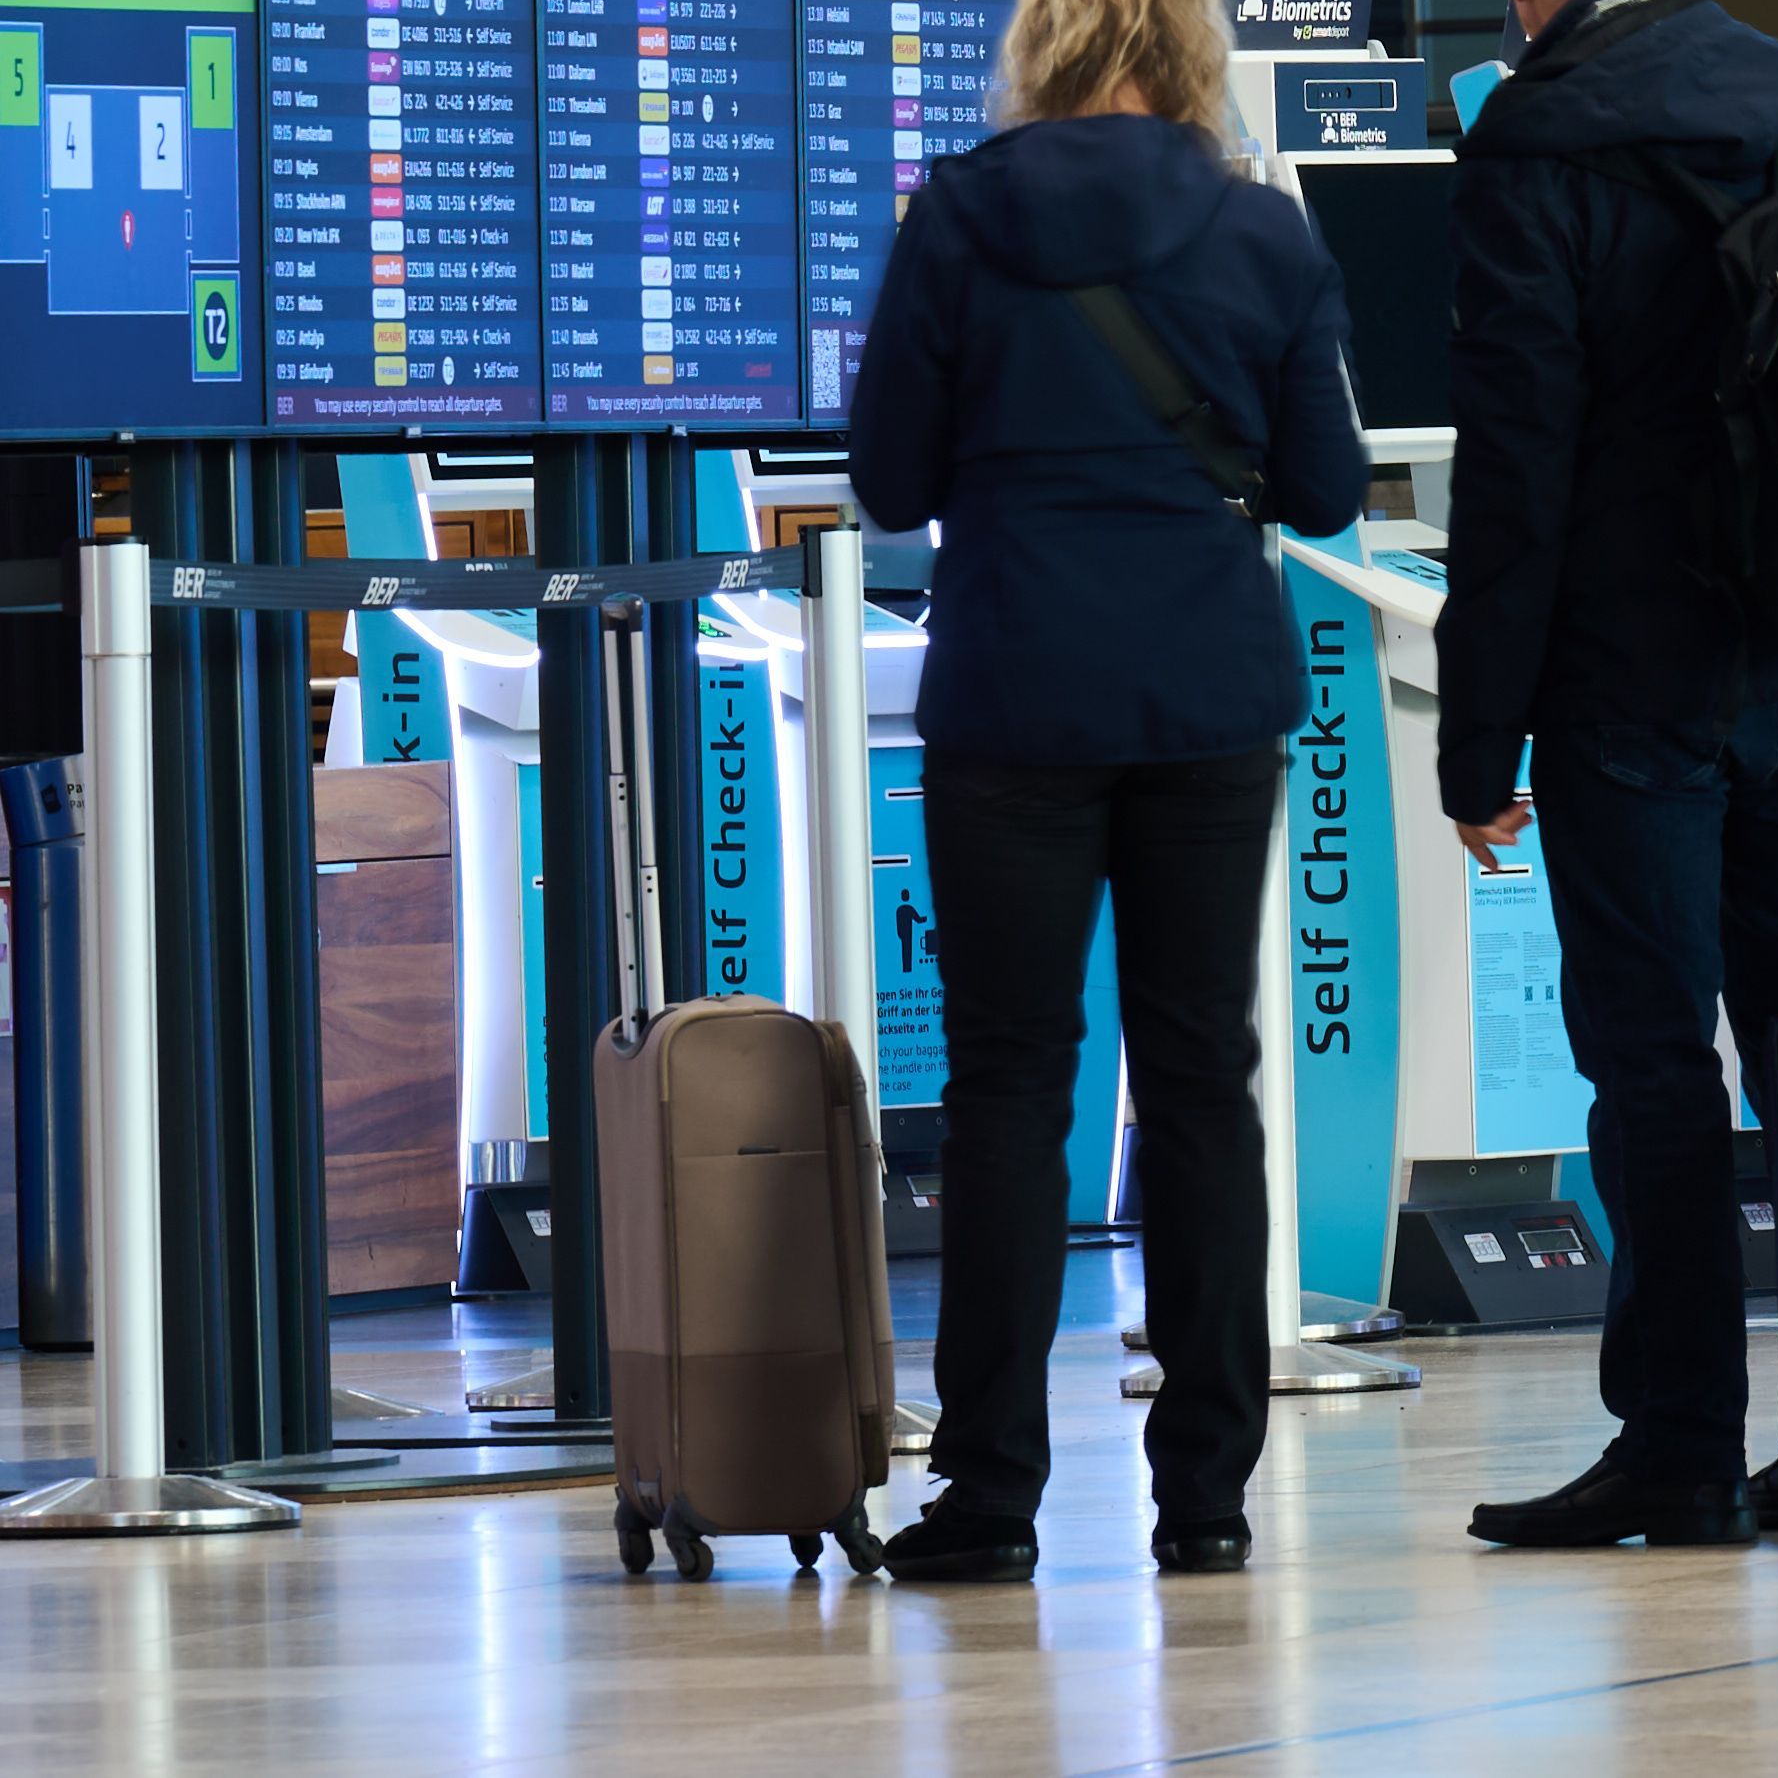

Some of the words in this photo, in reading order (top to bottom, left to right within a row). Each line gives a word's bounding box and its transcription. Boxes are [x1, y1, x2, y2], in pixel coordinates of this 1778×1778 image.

[14, 58, 25, 98] 5
[1340, 112, 1358, 127] BER
[65, 120, 77, 161] 4
[155, 120, 167, 162] 2
[1340, 127, 1388, 143] Biometrics
[204, 305, 228, 346] T2
[173, 567, 205, 599] BER
[543, 573, 580, 602] BER
[719, 559, 750, 590] BER
[362, 577, 399, 606] BER
[383, 651, 421, 762] k-in
[1298, 618, 1349, 907] Check-in
[876, 990, 897, 1003] ngen
[899, 987, 913, 1001] Sie
[914, 987, 929, 1000] Ihr
[1302, 925, 1351, 1056] Self
[901, 1006, 913, 1018] an
[914, 1004, 931, 1017] der
[917, 1023, 930, 1034] an
[891, 1060, 922, 1074] handle
[924, 1060, 937, 1072] on
[939, 1058, 949, 1072] th
[893, 1045, 914, 1061] your
[892, 1079, 912, 1092] case
